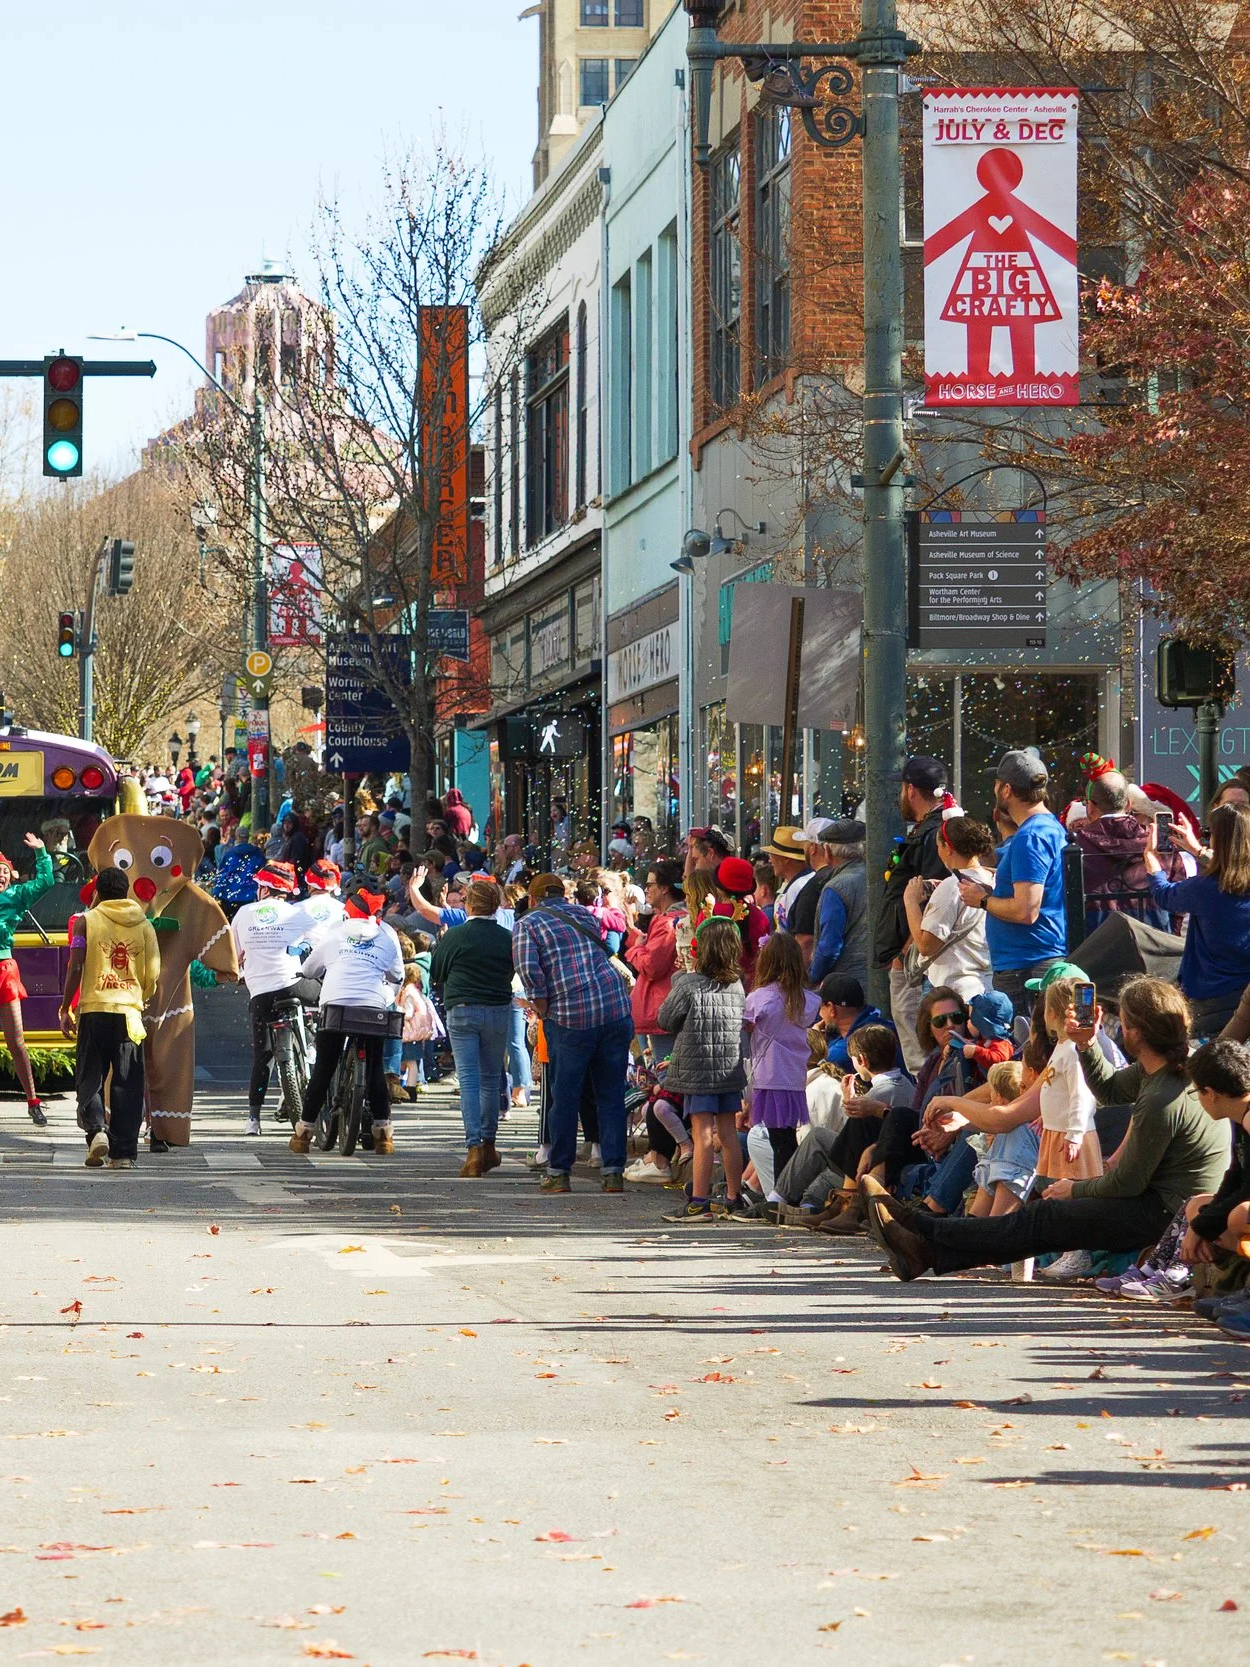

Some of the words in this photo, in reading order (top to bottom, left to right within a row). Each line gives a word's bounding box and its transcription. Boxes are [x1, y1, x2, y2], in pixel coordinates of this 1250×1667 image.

[935, 123, 986, 141] JULY
[993, 123, 1011, 141] &
[1019, 122, 1064, 141] DEC
[983, 254, 1018, 268] THE
[971, 270, 1031, 295] BIG
[951, 297, 1049, 316] CRAFTY
[938, 384, 996, 400] HORSE
[999, 387, 1013, 395] AND
[1016, 383, 1064, 399] HERO
[928, 530, 957, 538] Asheville
[959, 530, 969, 538] Art
[970, 530, 997, 538] Museum
[928, 551, 957, 559] Asheville
[959, 551, 986, 559] Museum
[987, 551, 995, 559] of
[995, 551, 1020, 559] Science
[929, 572, 944, 580] Pack
[945, 572, 968, 581] Square
[969, 572, 984, 580] Park
[929, 588, 958, 596] Wortham
[959, 588, 981, 596] Center
[929, 596, 938, 604] for
[940, 596, 951, 604] the
[952, 596, 988, 606] Performing
[989, 596, 1002, 604] Arts
[929, 613, 990, 622] Biltmore/Broadway
[991, 613, 1008, 622] Shop
[1009, 613, 1014, 621] &
[1015, 613, 1031, 621] Dine
[253, 656, 266, 672] P
[328, 735, 389, 747] Courthouse
